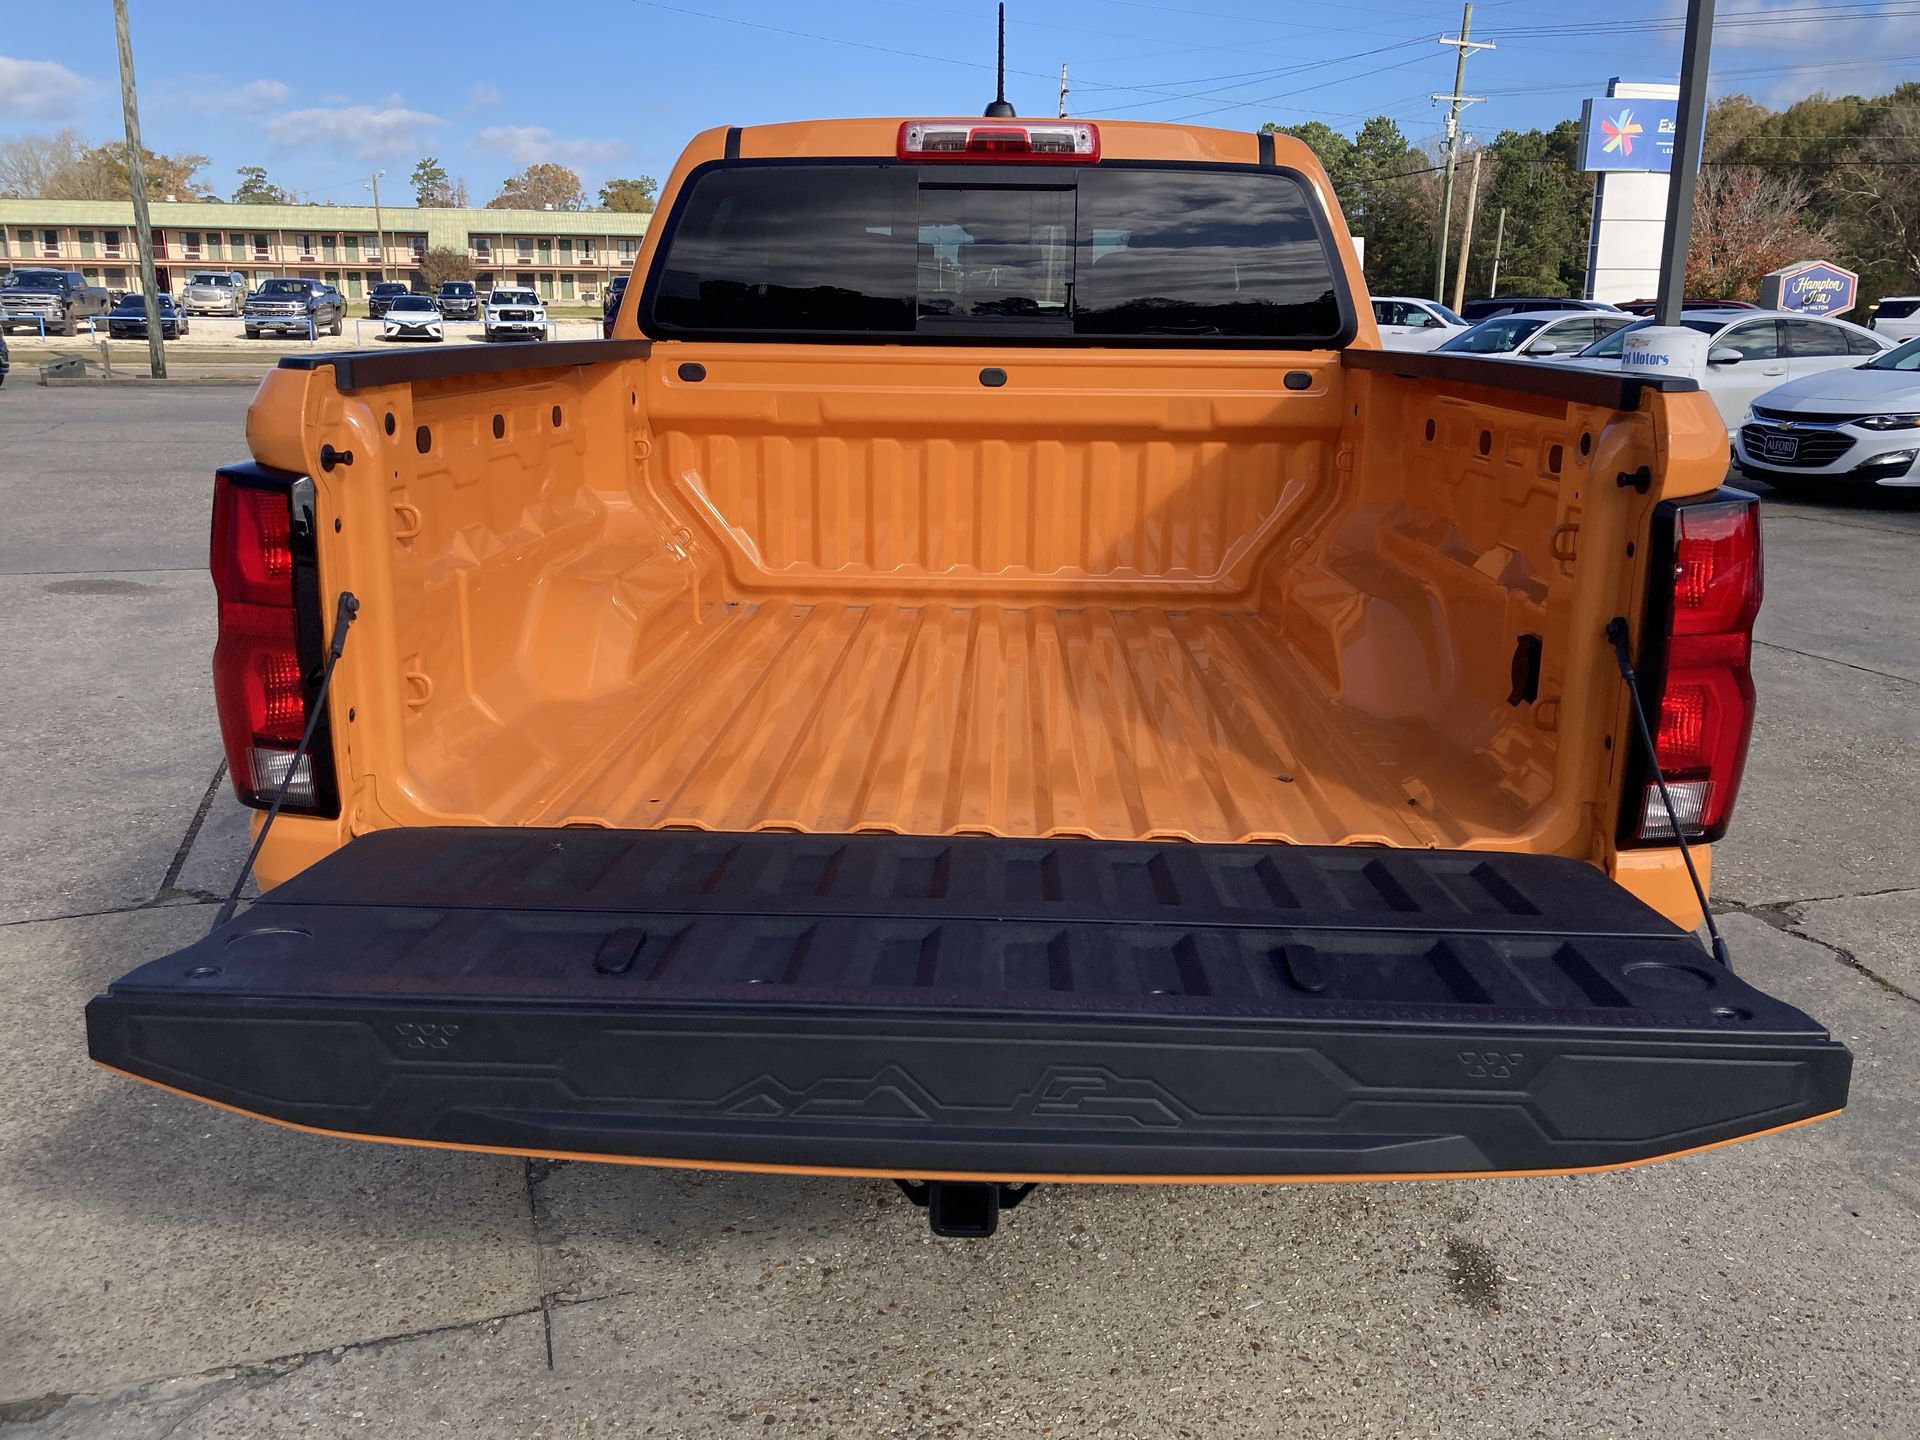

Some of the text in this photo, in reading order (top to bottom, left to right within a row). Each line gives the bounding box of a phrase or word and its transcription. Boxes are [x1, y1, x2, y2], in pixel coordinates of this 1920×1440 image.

[1792, 276, 1844, 294] Hampton
[1802, 291, 1831, 305] Inn
[1632, 352, 1669, 365] Motors
[1767, 440, 1795, 452] ALFORD
